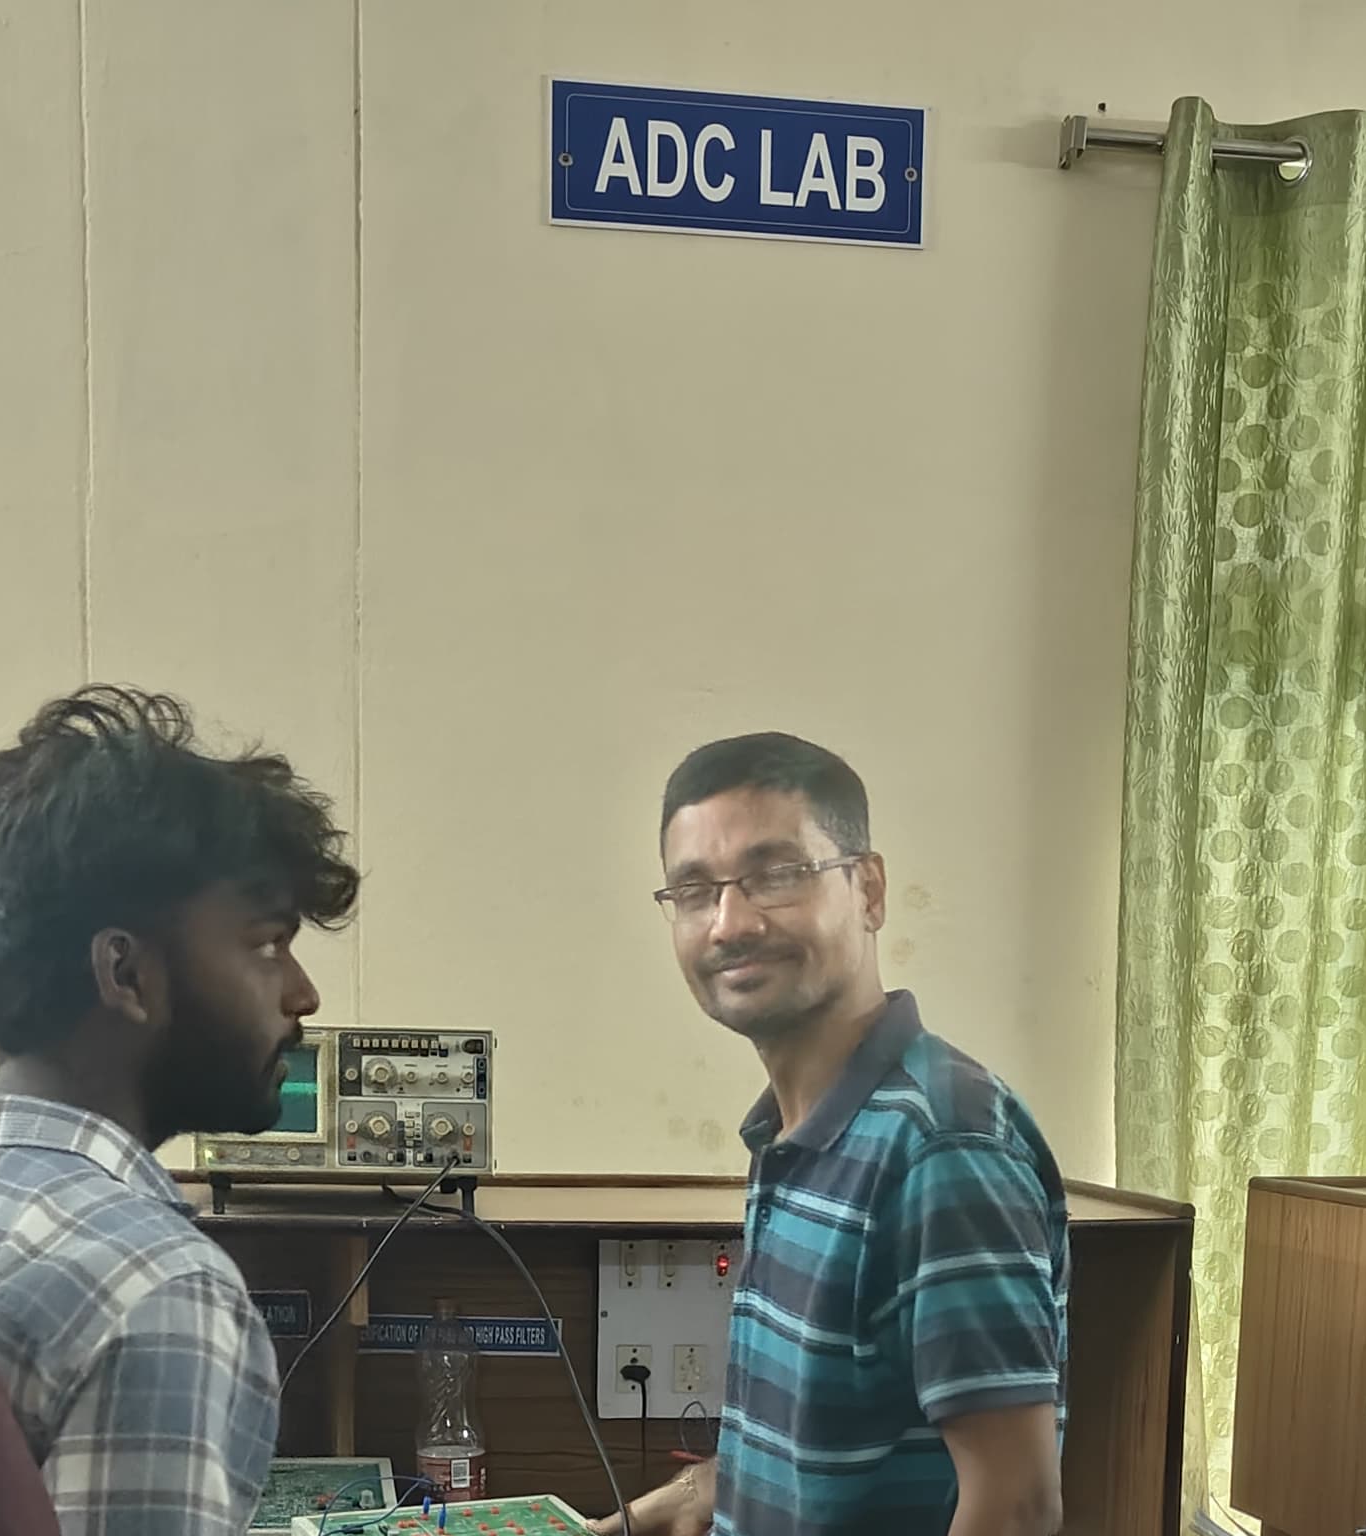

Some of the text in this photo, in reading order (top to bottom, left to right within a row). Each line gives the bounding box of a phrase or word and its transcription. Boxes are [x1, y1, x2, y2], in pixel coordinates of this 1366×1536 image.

[594, 116, 886, 213] ADC LAB
[407, 1323, 419, 1343] OF
[475, 1326, 494, 1344] HIGH
[495, 1326, 515, 1345] PASS
[515, 1327, 545, 1345] FILTERS
